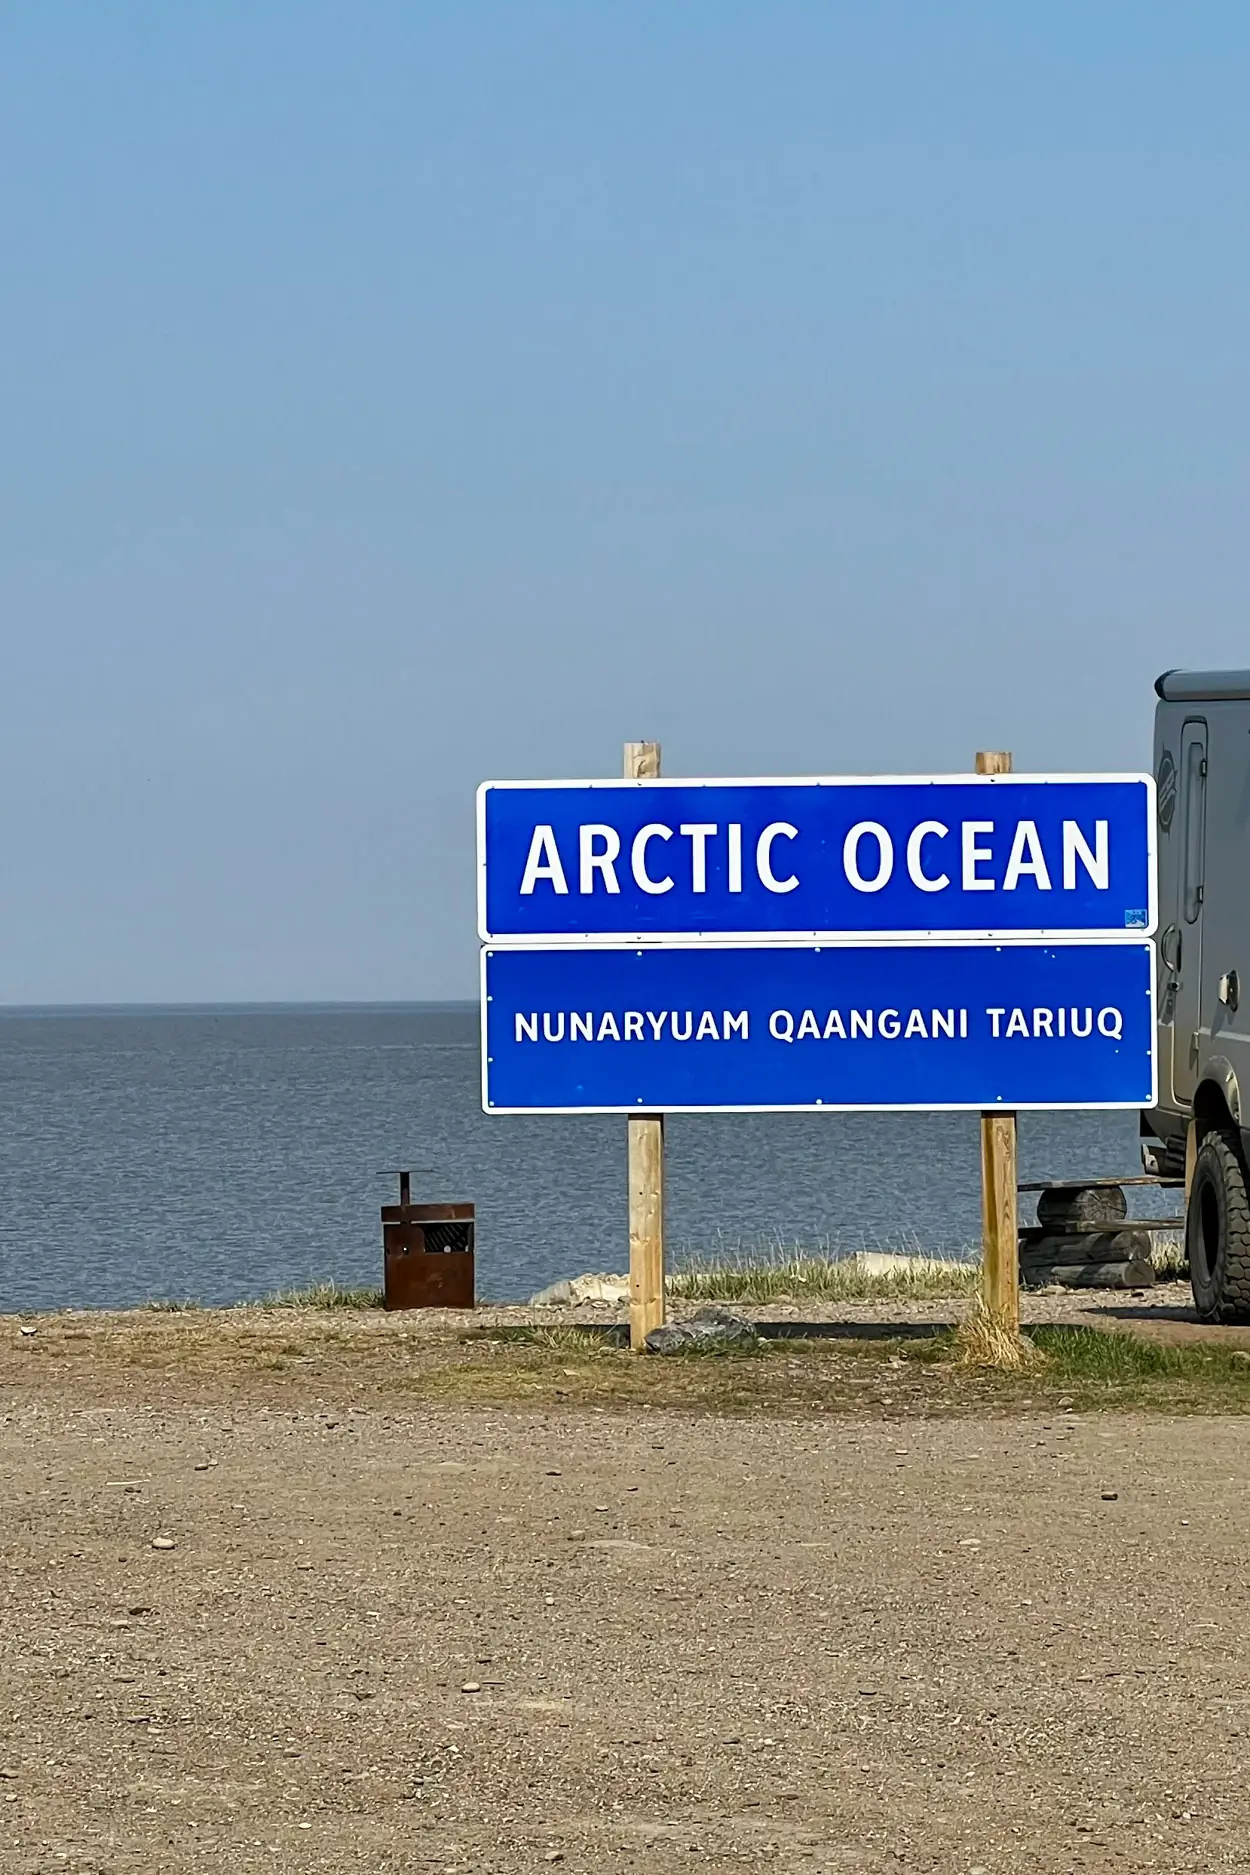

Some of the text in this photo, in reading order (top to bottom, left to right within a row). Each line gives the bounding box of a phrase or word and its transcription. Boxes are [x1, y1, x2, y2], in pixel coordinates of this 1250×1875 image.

[520, 821, 1108, 894] ARCTIC OCEAN
[516, 1007, 1122, 1042] NUNARYUAM QAANGANI TARIUQ
